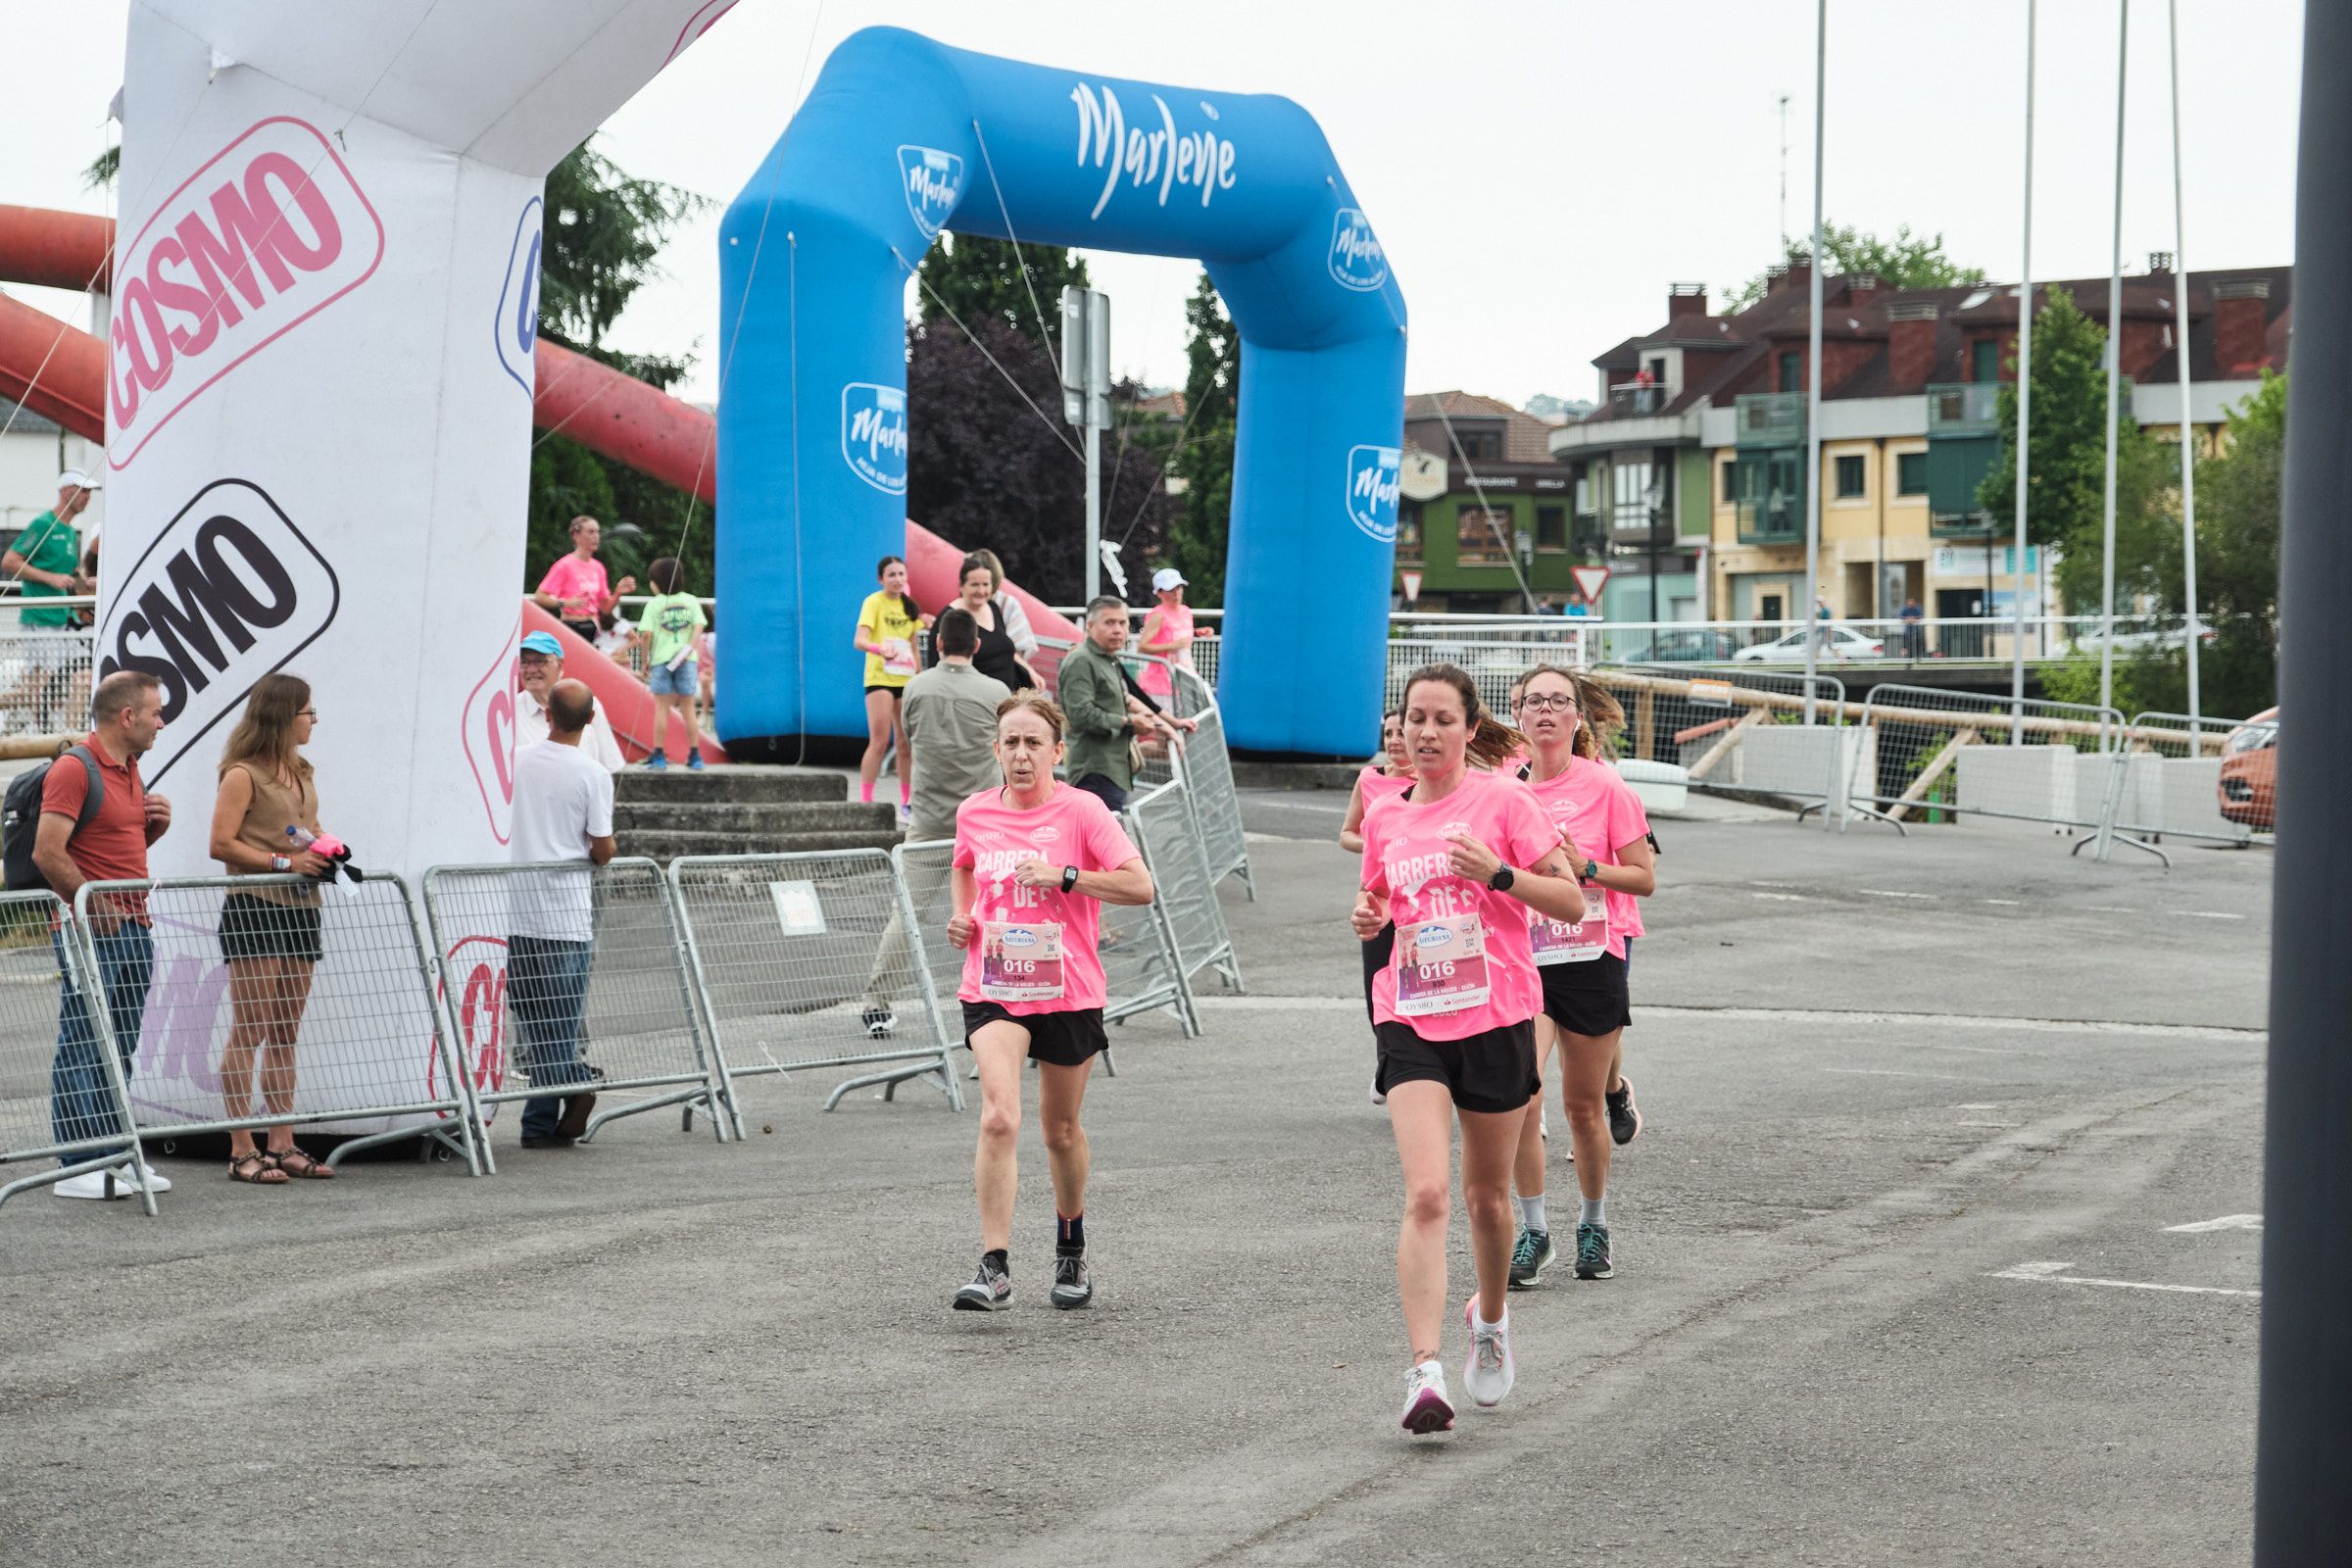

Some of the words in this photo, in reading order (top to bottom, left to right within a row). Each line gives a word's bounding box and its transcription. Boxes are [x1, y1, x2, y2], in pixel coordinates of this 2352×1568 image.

[1070, 81, 1236, 220] Marlene
[110, 152, 342, 430] COSMO
[1551, 922, 1584, 936] 016
[1004, 959, 1036, 974] 016
[1419, 960, 1456, 980] 016
